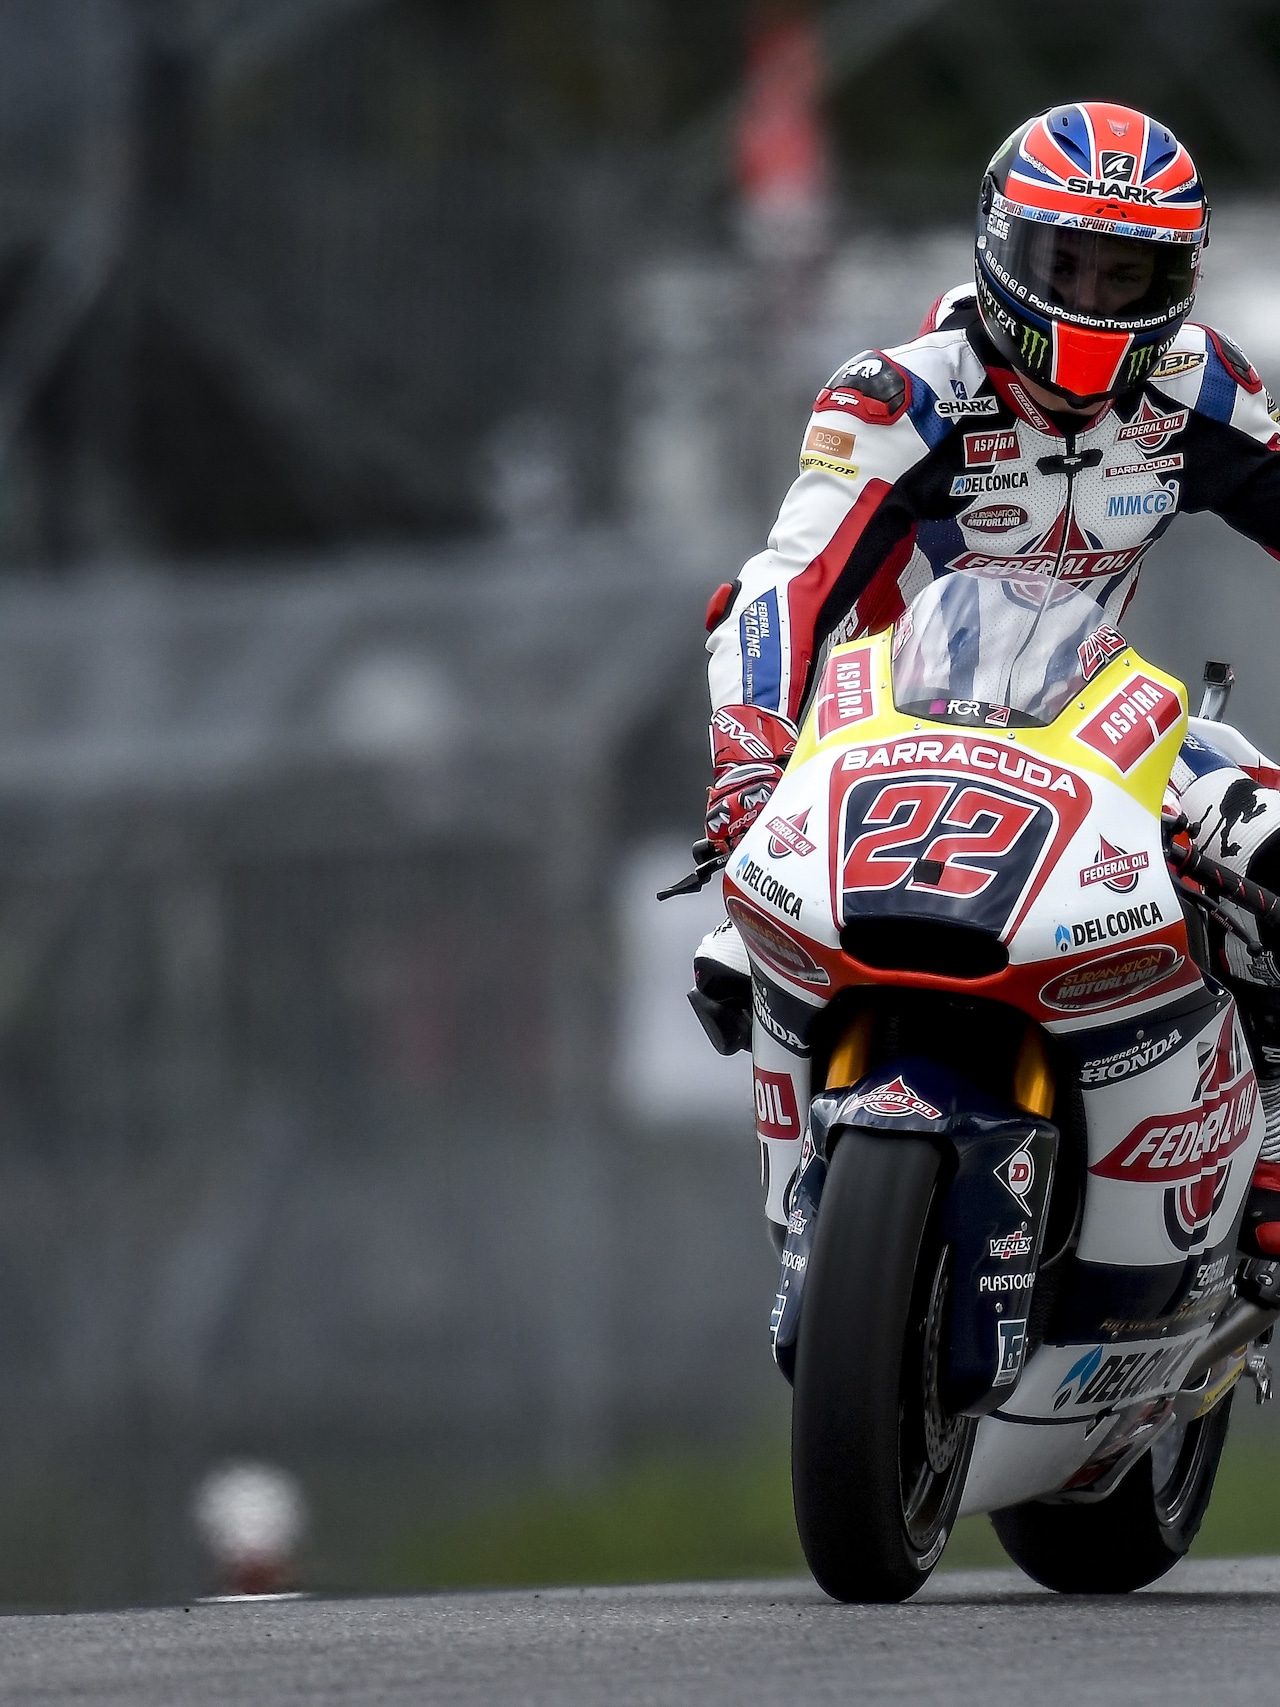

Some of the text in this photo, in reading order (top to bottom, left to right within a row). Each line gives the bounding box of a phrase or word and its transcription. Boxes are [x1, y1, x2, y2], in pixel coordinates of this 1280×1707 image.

[1067, 179, 1161, 205] SHARK
[1029, 293, 1167, 328] PolePositionTravel.com
[938, 399, 994, 414] SHARK
[1121, 414, 1180, 438] FEDERAL OIL
[805, 458, 855, 476] DUNLOP
[1110, 459, 1175, 476] BARRACUDA
[1108, 494, 1168, 517] MMCG
[967, 516, 1020, 527] MOTORLAND
[966, 551, 1129, 576] FEDERAL OIL
[757, 601, 770, 638] FEDERAL
[841, 741, 1077, 799] BARRACUDA
[794, 840, 812, 855] OIL
[842, 781, 1040, 900] 22
[1083, 854, 1148, 883] FEDERAL OIL
[1063, 951, 1162, 985] SURYANATION
[1056, 965, 1159, 1000] MOTORLAND
[752, 997, 810, 1050] ONDA
[1079, 1028, 1183, 1082] HONDA
[1083, 1039, 1152, 1068] POWERED by
[755, 1078, 792, 1127] OIL
[911, 1101, 935, 1116] OIL
[990, 1236, 1033, 1252] VERTEX
